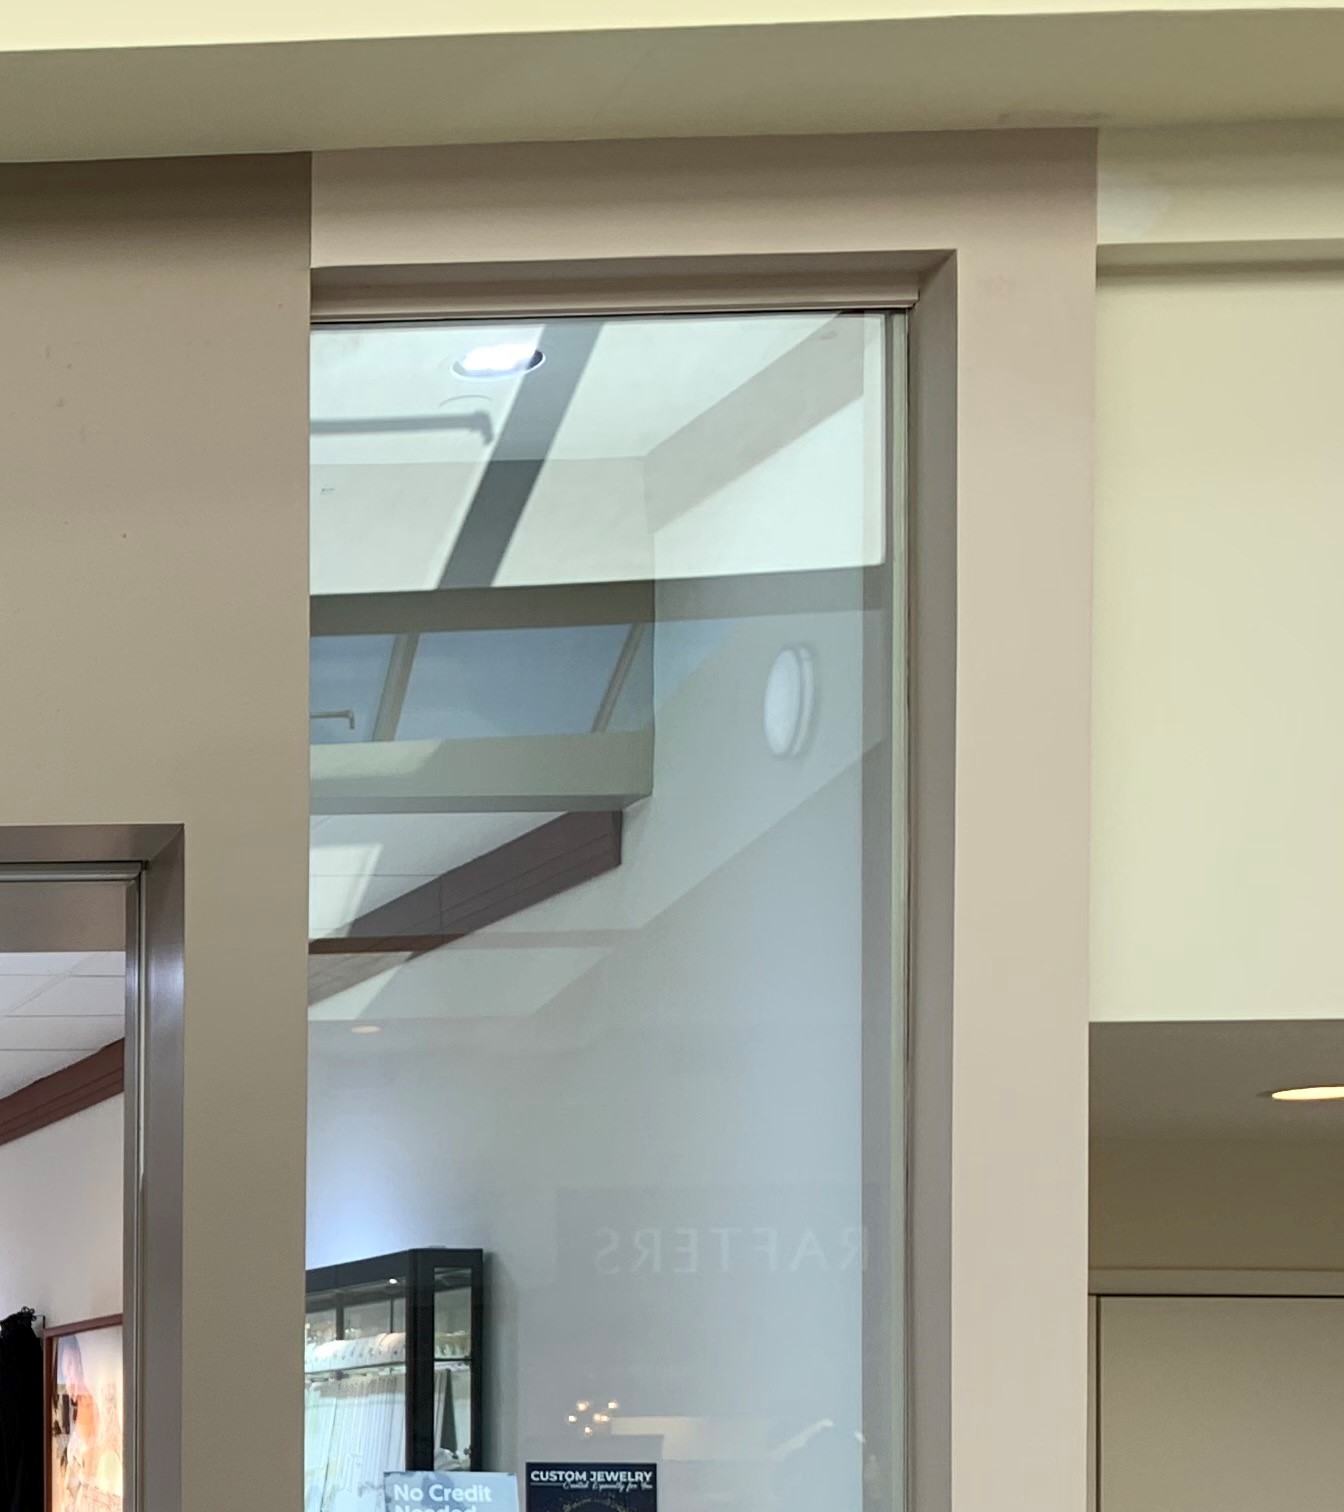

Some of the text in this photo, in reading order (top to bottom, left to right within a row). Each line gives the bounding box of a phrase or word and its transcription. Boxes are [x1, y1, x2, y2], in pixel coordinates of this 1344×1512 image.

[530, 1471, 653, 1482] CUSTOM JEWELRY
[393, 1484, 492, 1502] No Credit
